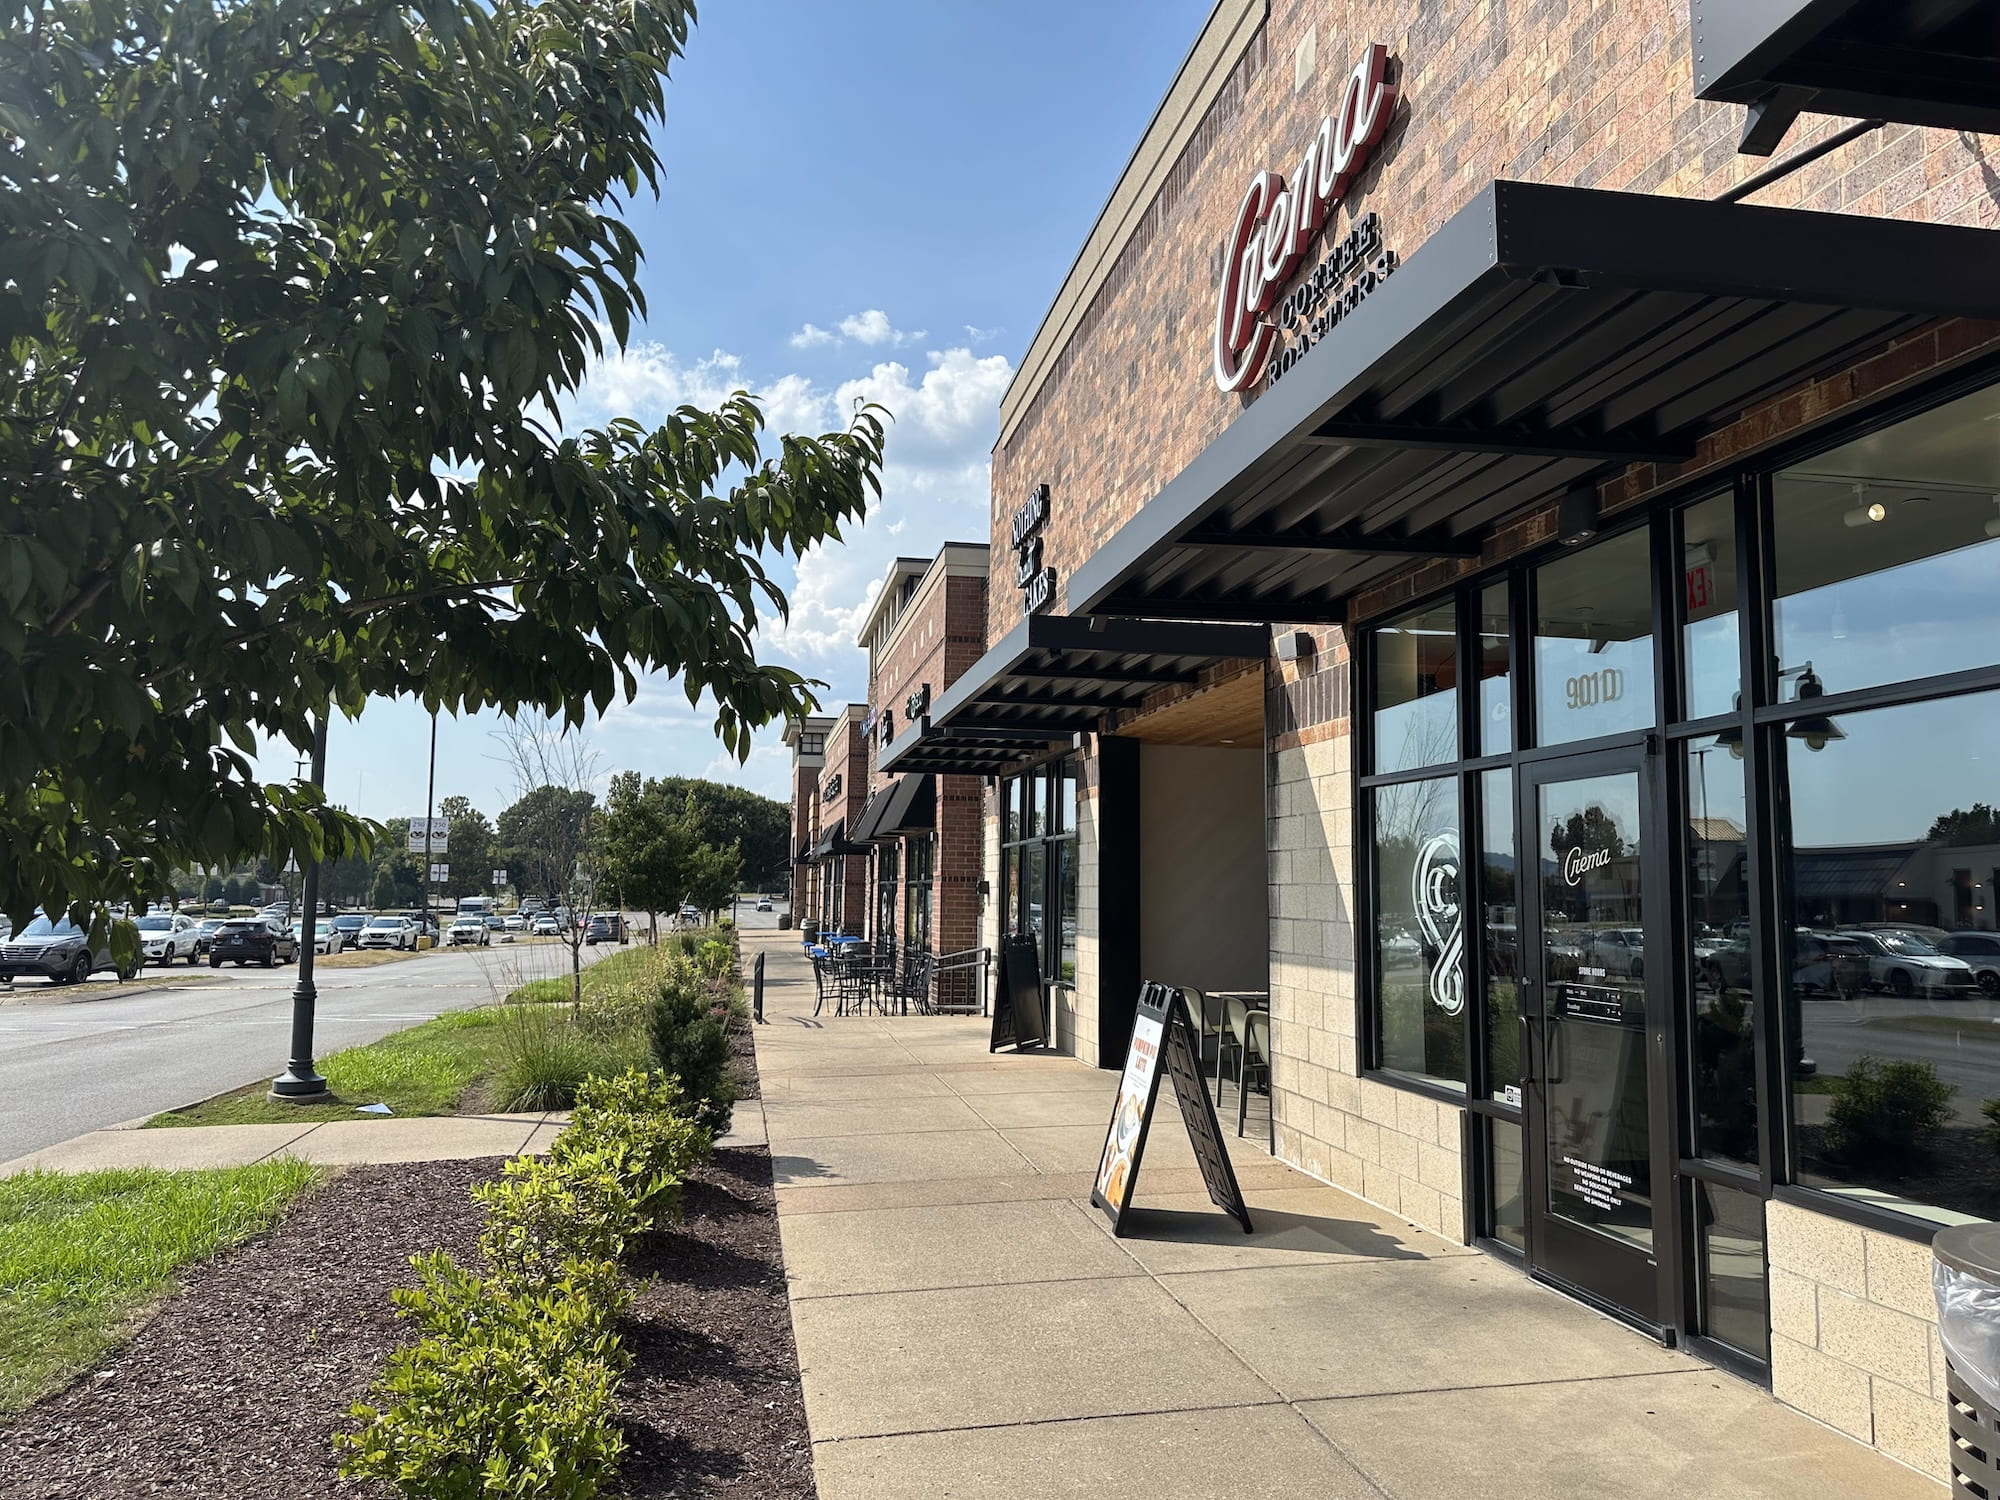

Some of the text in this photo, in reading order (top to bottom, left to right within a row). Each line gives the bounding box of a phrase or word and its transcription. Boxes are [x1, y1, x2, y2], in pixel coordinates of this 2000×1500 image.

[1214, 44, 1396, 392] Crema
[1279, 212, 1379, 330] COFFEE
[1266, 251, 1396, 389] ROASTERS
[1564, 846, 1611, 886] Crema
[1606, 1170, 1632, 1184] BEVERAGES
